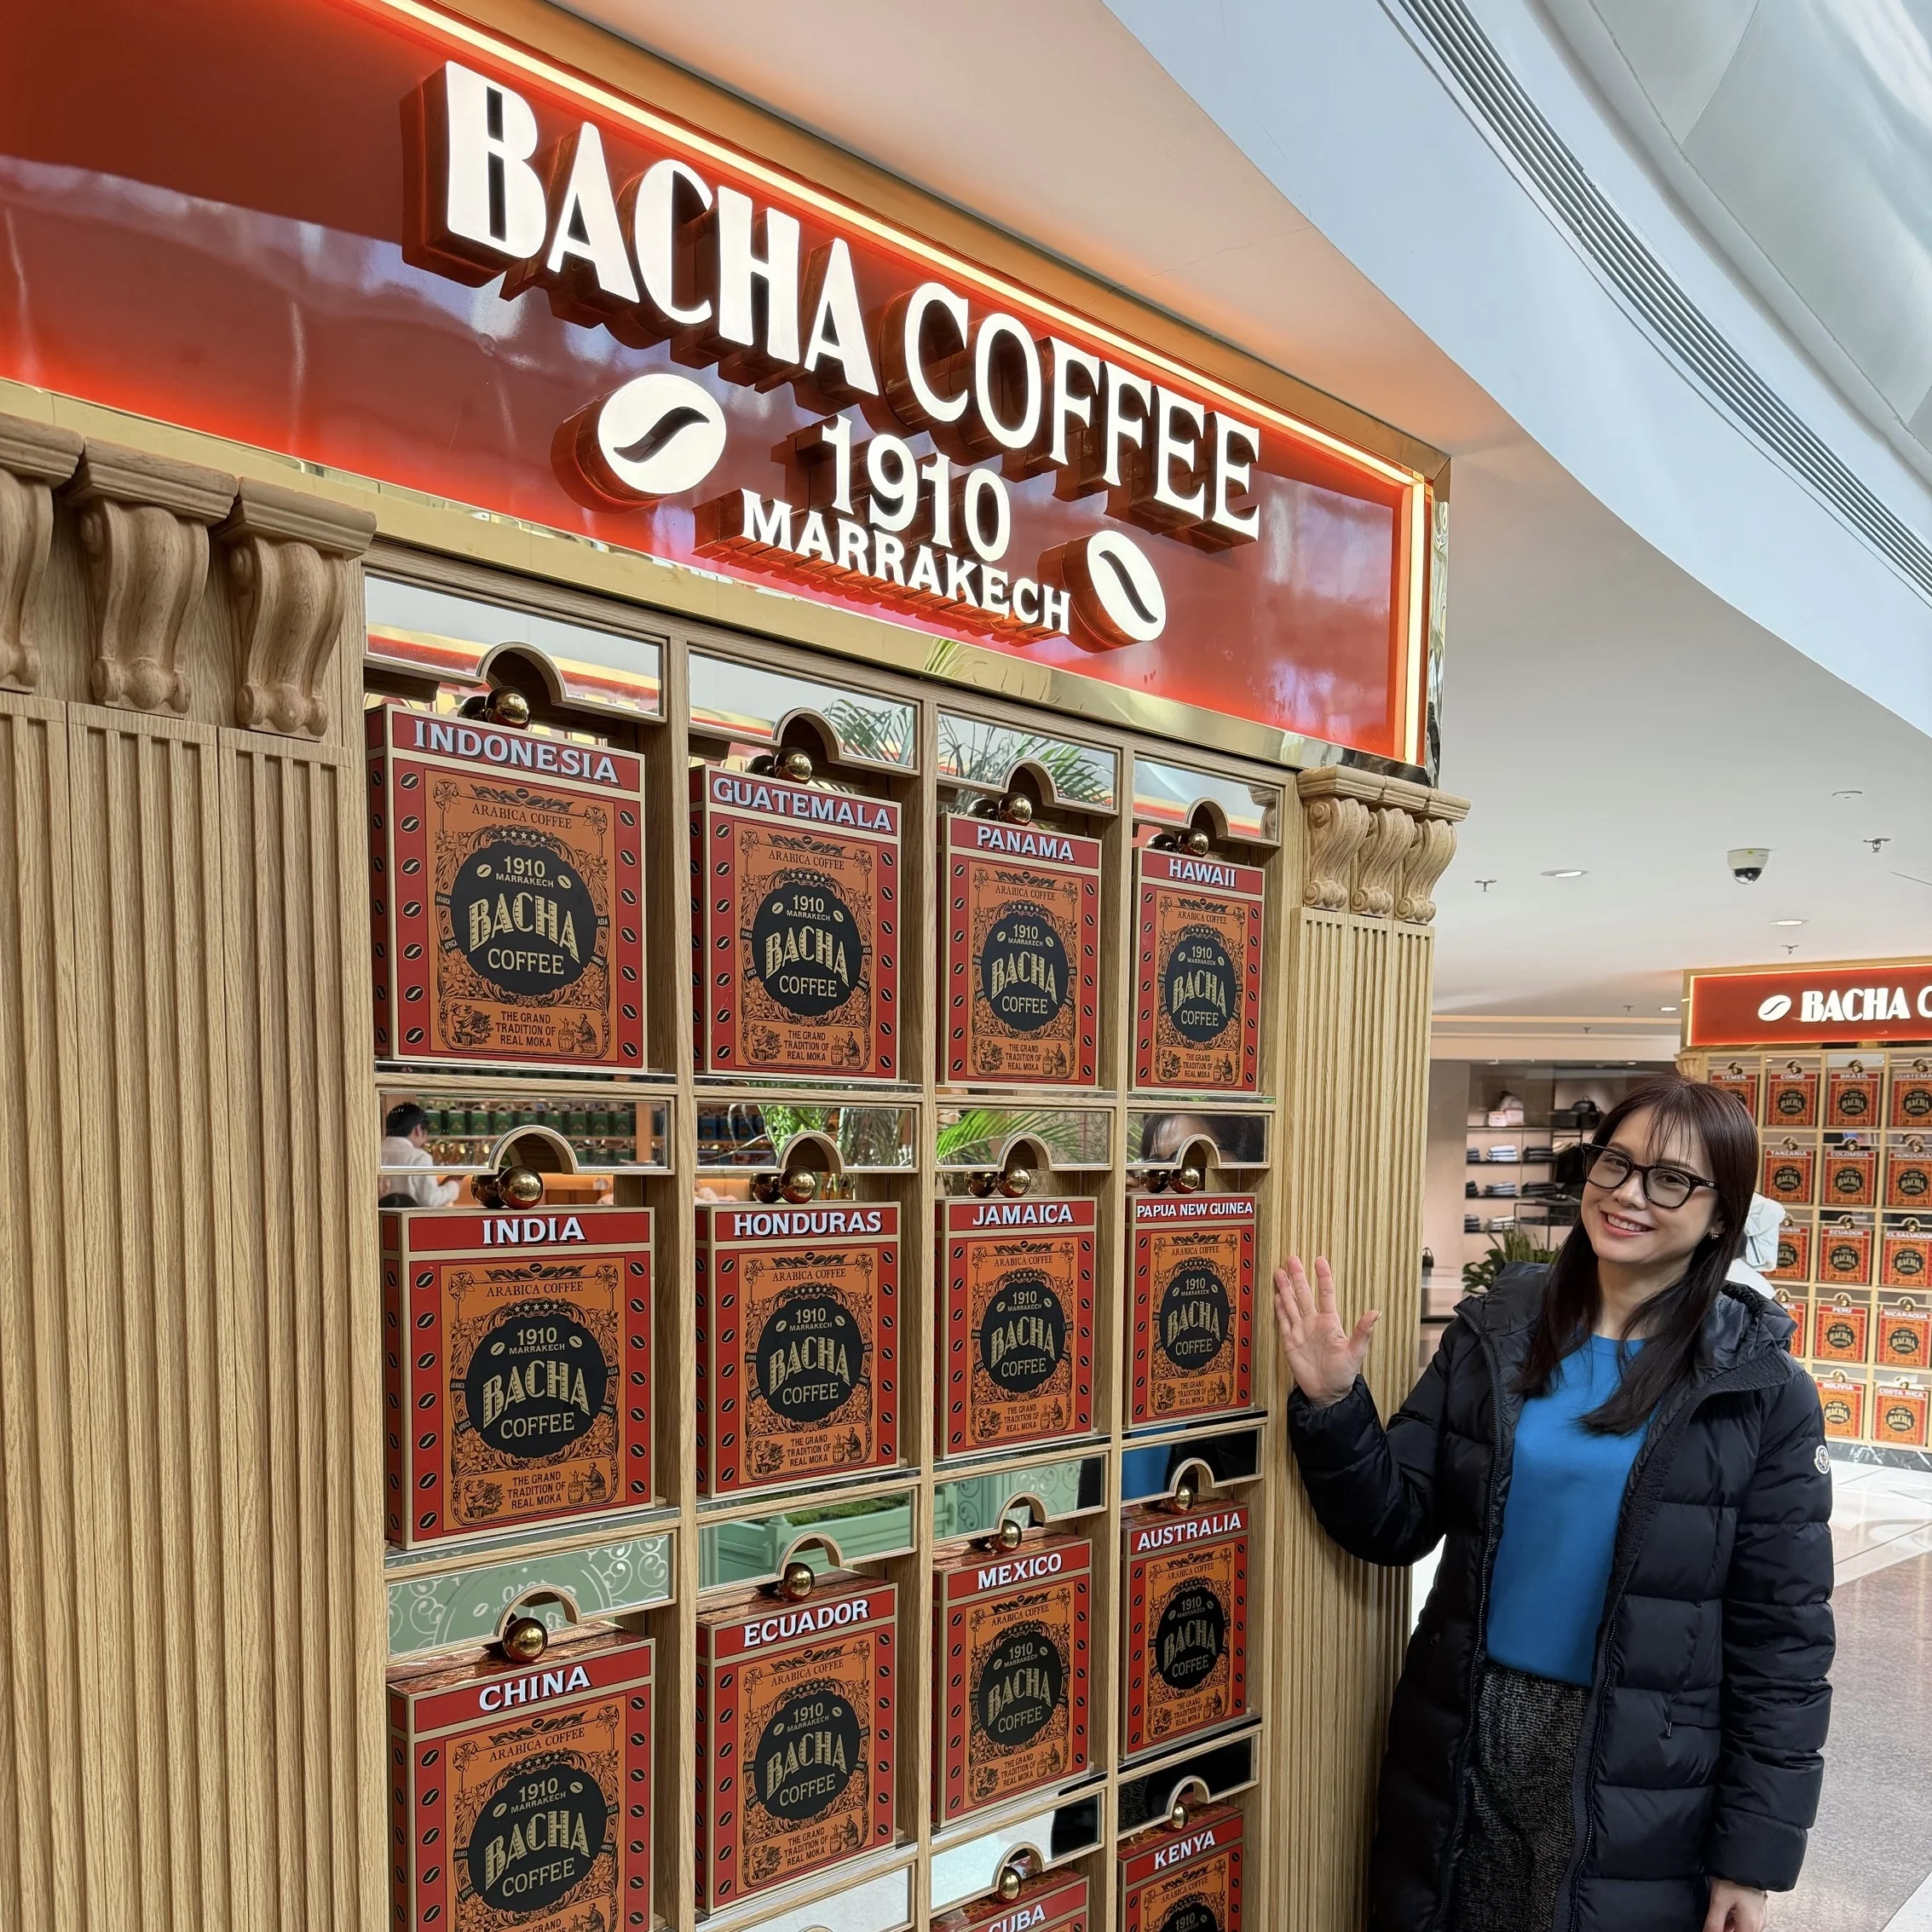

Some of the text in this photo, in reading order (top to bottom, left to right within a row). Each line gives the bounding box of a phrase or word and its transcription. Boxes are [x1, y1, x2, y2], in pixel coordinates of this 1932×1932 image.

[446, 60, 1260, 541] BACHA COFFEE
[822, 414, 1012, 562] 1910
[741, 487, 1070, 636] MARRAKECH
[414, 719, 620, 784] INDONESIA
[470, 802, 572, 830] ARABICA COFFEE
[713, 777, 892, 832] GUATEMALA
[977, 825, 1075, 862] PANAMA
[503, 855, 545, 879] 1910
[768, 848, 845, 871] ARABICA COFFEE
[495, 872, 554, 888] MARRAKECH
[1168, 858, 1236, 887] HAWAII
[792, 894, 823, 914] 1910
[995, 884, 1056, 901] ARABICA COFFEE
[785, 908, 830, 922] MARRAKECH
[469, 891, 580, 964] BACHA
[1012, 923, 1038, 940] 1910
[1007, 937, 1043, 947] MARRAKECH
[1191, 944, 1212, 960] 1910
[487, 947, 564, 975] COFFEE
[765, 925, 849, 988] BACHA
[778, 974, 837, 998] COFFEE
[991, 950, 1058, 1005] BACHA
[1001, 995, 1047, 1014] COFFEE
[1172, 969, 1226, 1018] BACHA
[1801, 987, 1911, 1022] BACHA
[495, 1022, 556, 1035] TRADITION OF
[500, 1011, 551, 1024] THE GRAND
[1180, 1009, 1219, 1027] COFFEE
[499, 1035, 551, 1047] REAL MOKA
[783, 1040, 829, 1051] TRADITION OF
[787, 1029, 826, 1041] THE GRAND
[787, 1050, 826, 1061] REAL MOKA
[972, 1204, 1074, 1226] JAMAICA
[1137, 1202, 1254, 1218] PAPUA NEW GUINEA
[482, 1217, 585, 1245] INDIA
[734, 1211, 882, 1237] HONDURAS
[994, 1254, 1053, 1266] ARABICA COFFEE
[772, 1267, 846, 1282] ARABICA COFFEE
[1185, 1277, 1205, 1290] 1910
[486, 1281, 584, 1297] ARABICA COFFEE
[1011, 1290, 1036, 1305] 1910
[794, 1307, 826, 1324] 1910
[1006, 1303, 1041, 1312] MARRAKECH
[788, 1321, 832, 1332] MARRAKECH
[1167, 1300, 1220, 1348] BACHA
[516, 1326, 557, 1346] 1910
[990, 1315, 1055, 1369] BACHA
[1174, 1338, 1213, 1356] COFFEE
[508, 1342, 565, 1355] MARRAKECH
[769, 1335, 851, 1396] BACHA
[1000, 1357, 1046, 1378] COFFEE
[482, 1359, 591, 1429] BACHA
[781, 1381, 839, 1405] COFFEE
[499, 1411, 574, 1439] COFFEE
[787, 1443, 831, 1457] TRADITION OF
[790, 1433, 828, 1447] THE GRAND
[790, 1453, 828, 1467] REAL MOKA
[506, 1480, 566, 1499] TRADITION OF
[511, 1470, 561, 1486] THE GRAND
[511, 1492, 562, 1509] REAL MOKA
[1137, 1513, 1242, 1551] AUSTRALIA
[978, 1553, 1062, 1590] MEXICO
[991, 1603, 1049, 1626] ARABICA COFFEE
[1180, 1595, 1201, 1612] 1910
[743, 1599, 868, 1648] ECUADOR
[1008, 1641, 1033, 1660] 1910
[1163, 1618, 1216, 1672] BACHA
[1003, 1652, 1037, 1668] MARRAKECH
[1171, 1653, 1208, 1678] COFFEE
[770, 1658, 844, 1687] ARABICA COFFEE
[479, 1665, 591, 1711] CHINA
[988, 1667, 1052, 1727] BACHA
[787, 1714, 829, 1733] MARRAKECH
[793, 1701, 823, 1724] 1910
[997, 1704, 1042, 1733] COFFEE
[488, 1726, 585, 1762] ARABICA COFFEE
[766, 1730, 847, 1801] BACHA
[518, 1777, 558, 1804] 1910
[779, 1772, 835, 1808] COFFEE
[510, 1791, 566, 1814] MARRAKECH
[783, 1834, 828, 1859] TRADITION OF
[787, 1826, 824, 1847] THE GRAND
[485, 1809, 591, 1892] BACHA
[787, 1845, 825, 1867] REAL MOKA
[1154, 1831, 1216, 1870] KENYA
[501, 1856, 574, 1899] COFFEE
[532, 1917, 561, 1932] GRAND
[1175, 1912, 1196, 1929] 1910
